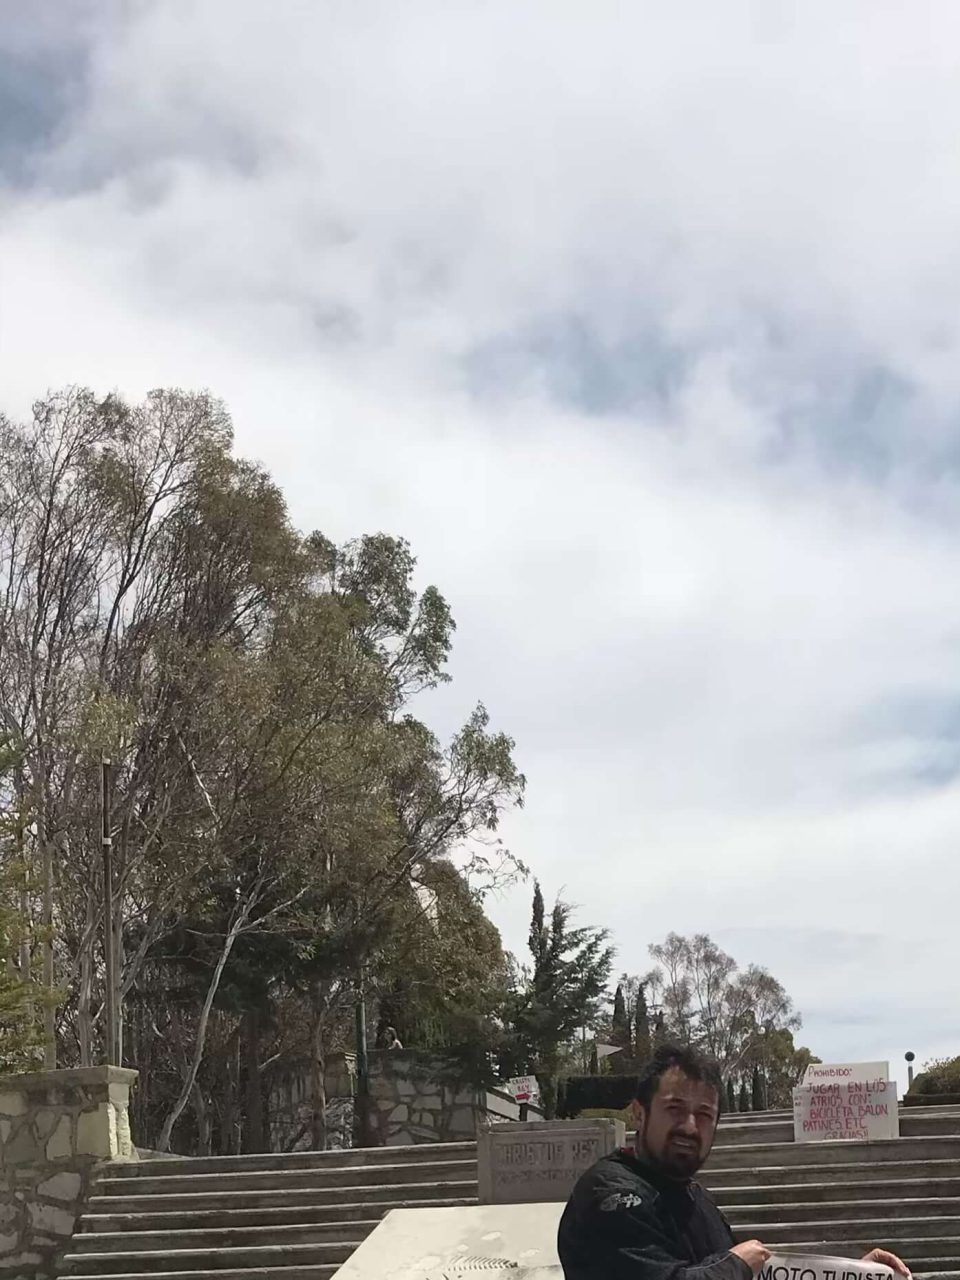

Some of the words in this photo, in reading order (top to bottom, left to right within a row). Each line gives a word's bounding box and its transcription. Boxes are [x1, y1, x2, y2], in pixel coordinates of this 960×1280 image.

[806, 1083, 840, 1095] JUGAR
[847, 1081, 863, 1094] EN
[865, 1078, 887, 1093] LOS
[810, 1094, 842, 1107] ATRIOS
[858, 1104, 888, 1118] BALON
